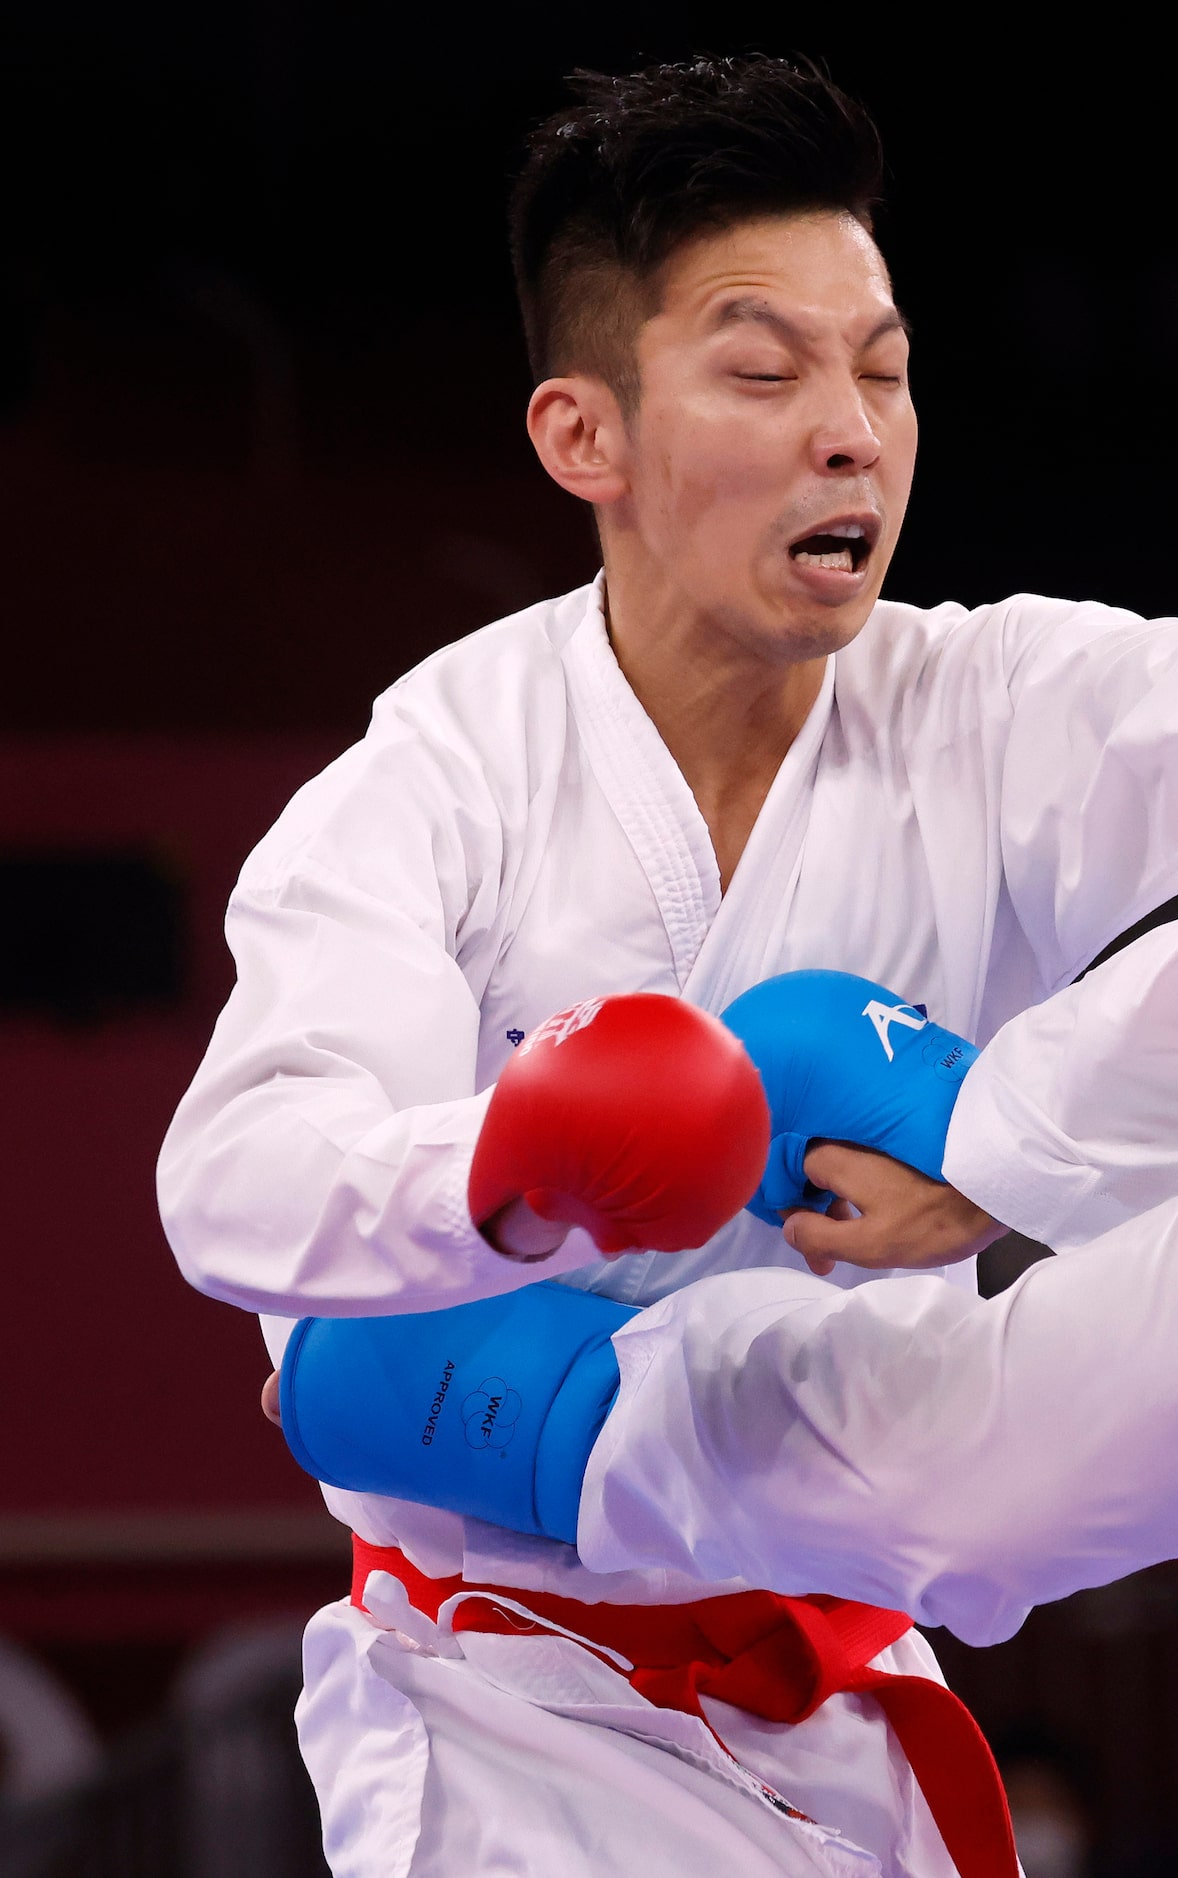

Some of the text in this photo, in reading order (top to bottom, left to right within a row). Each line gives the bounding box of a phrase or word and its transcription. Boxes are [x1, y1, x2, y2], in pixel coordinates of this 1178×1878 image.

[940, 1046, 964, 1070] WKF
[421, 1359, 456, 1447] APPROVED
[481, 1396, 503, 1439] WKF
